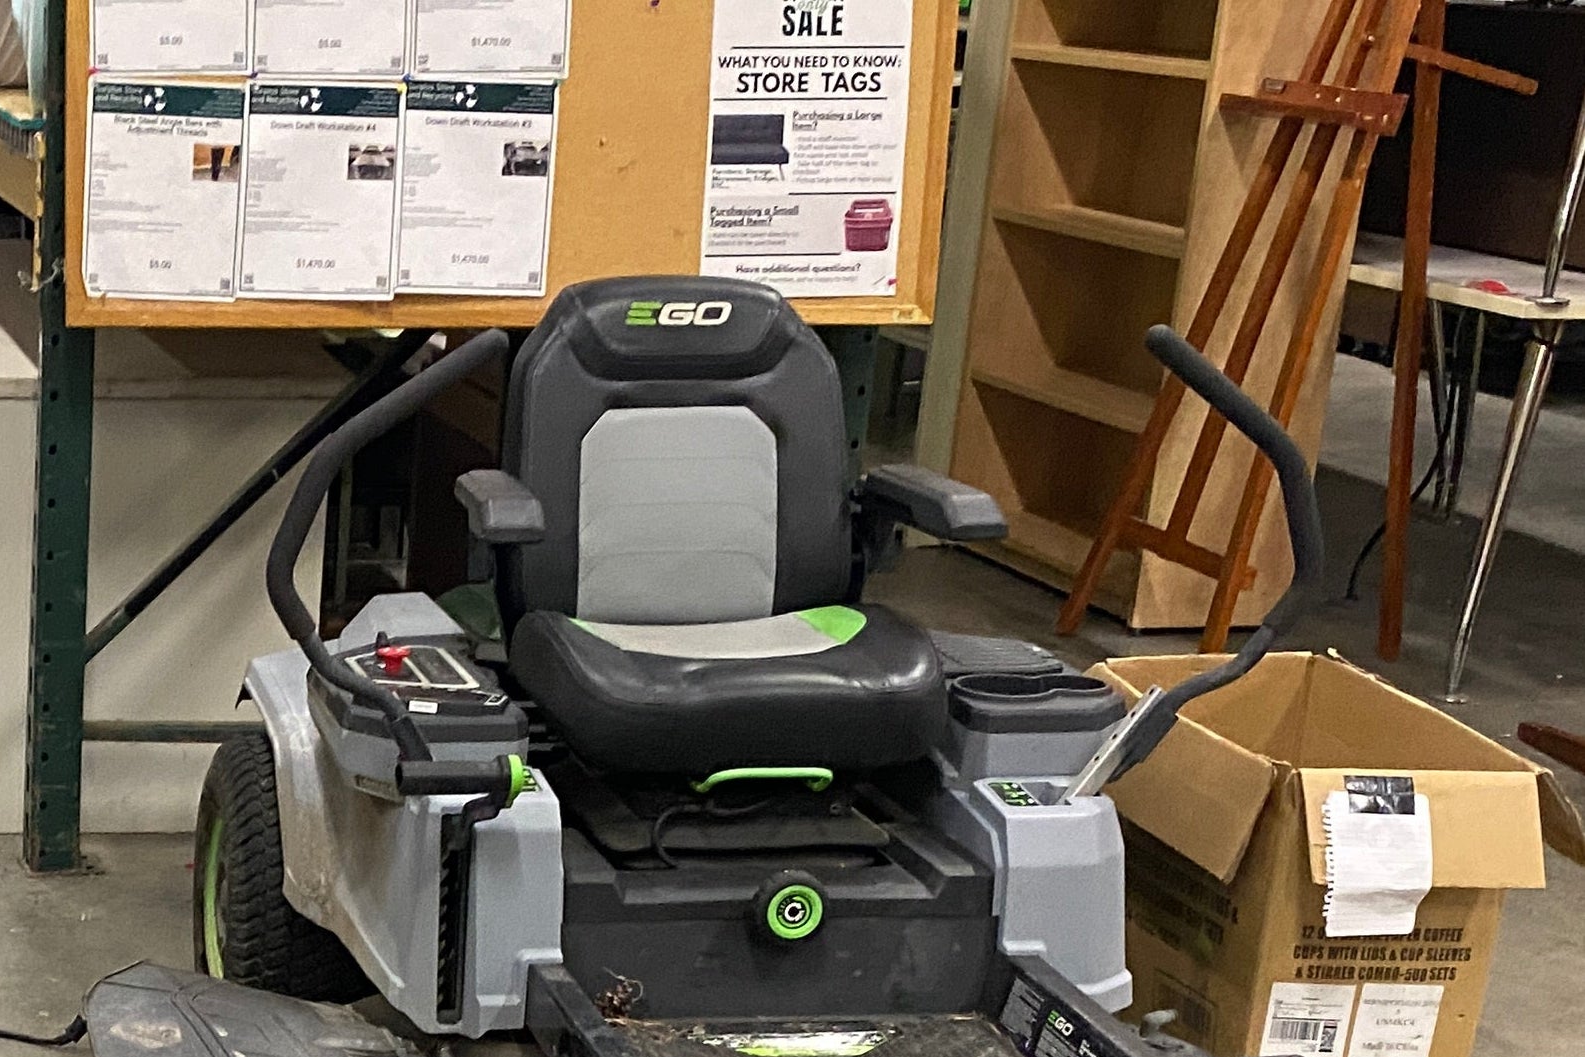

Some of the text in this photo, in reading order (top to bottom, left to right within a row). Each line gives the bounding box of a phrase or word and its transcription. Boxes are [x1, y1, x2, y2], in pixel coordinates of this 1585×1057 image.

[782, 5, 844, 36] SALE
[718, 54, 902, 69] WHAT YOU NEED TO KNOW:
[736, 71, 882, 93] STORE TAGS
[625, 300, 733, 326] EGO
[1293, 944, 1324, 960] CUPS
[1327, 945, 1358, 961] WITH
[1360, 946, 1387, 961] LIDS
[1400, 947, 1424, 962] CUP
[1429, 966, 1457, 981] SETS
[1047, 1010, 1074, 1037] EGO
